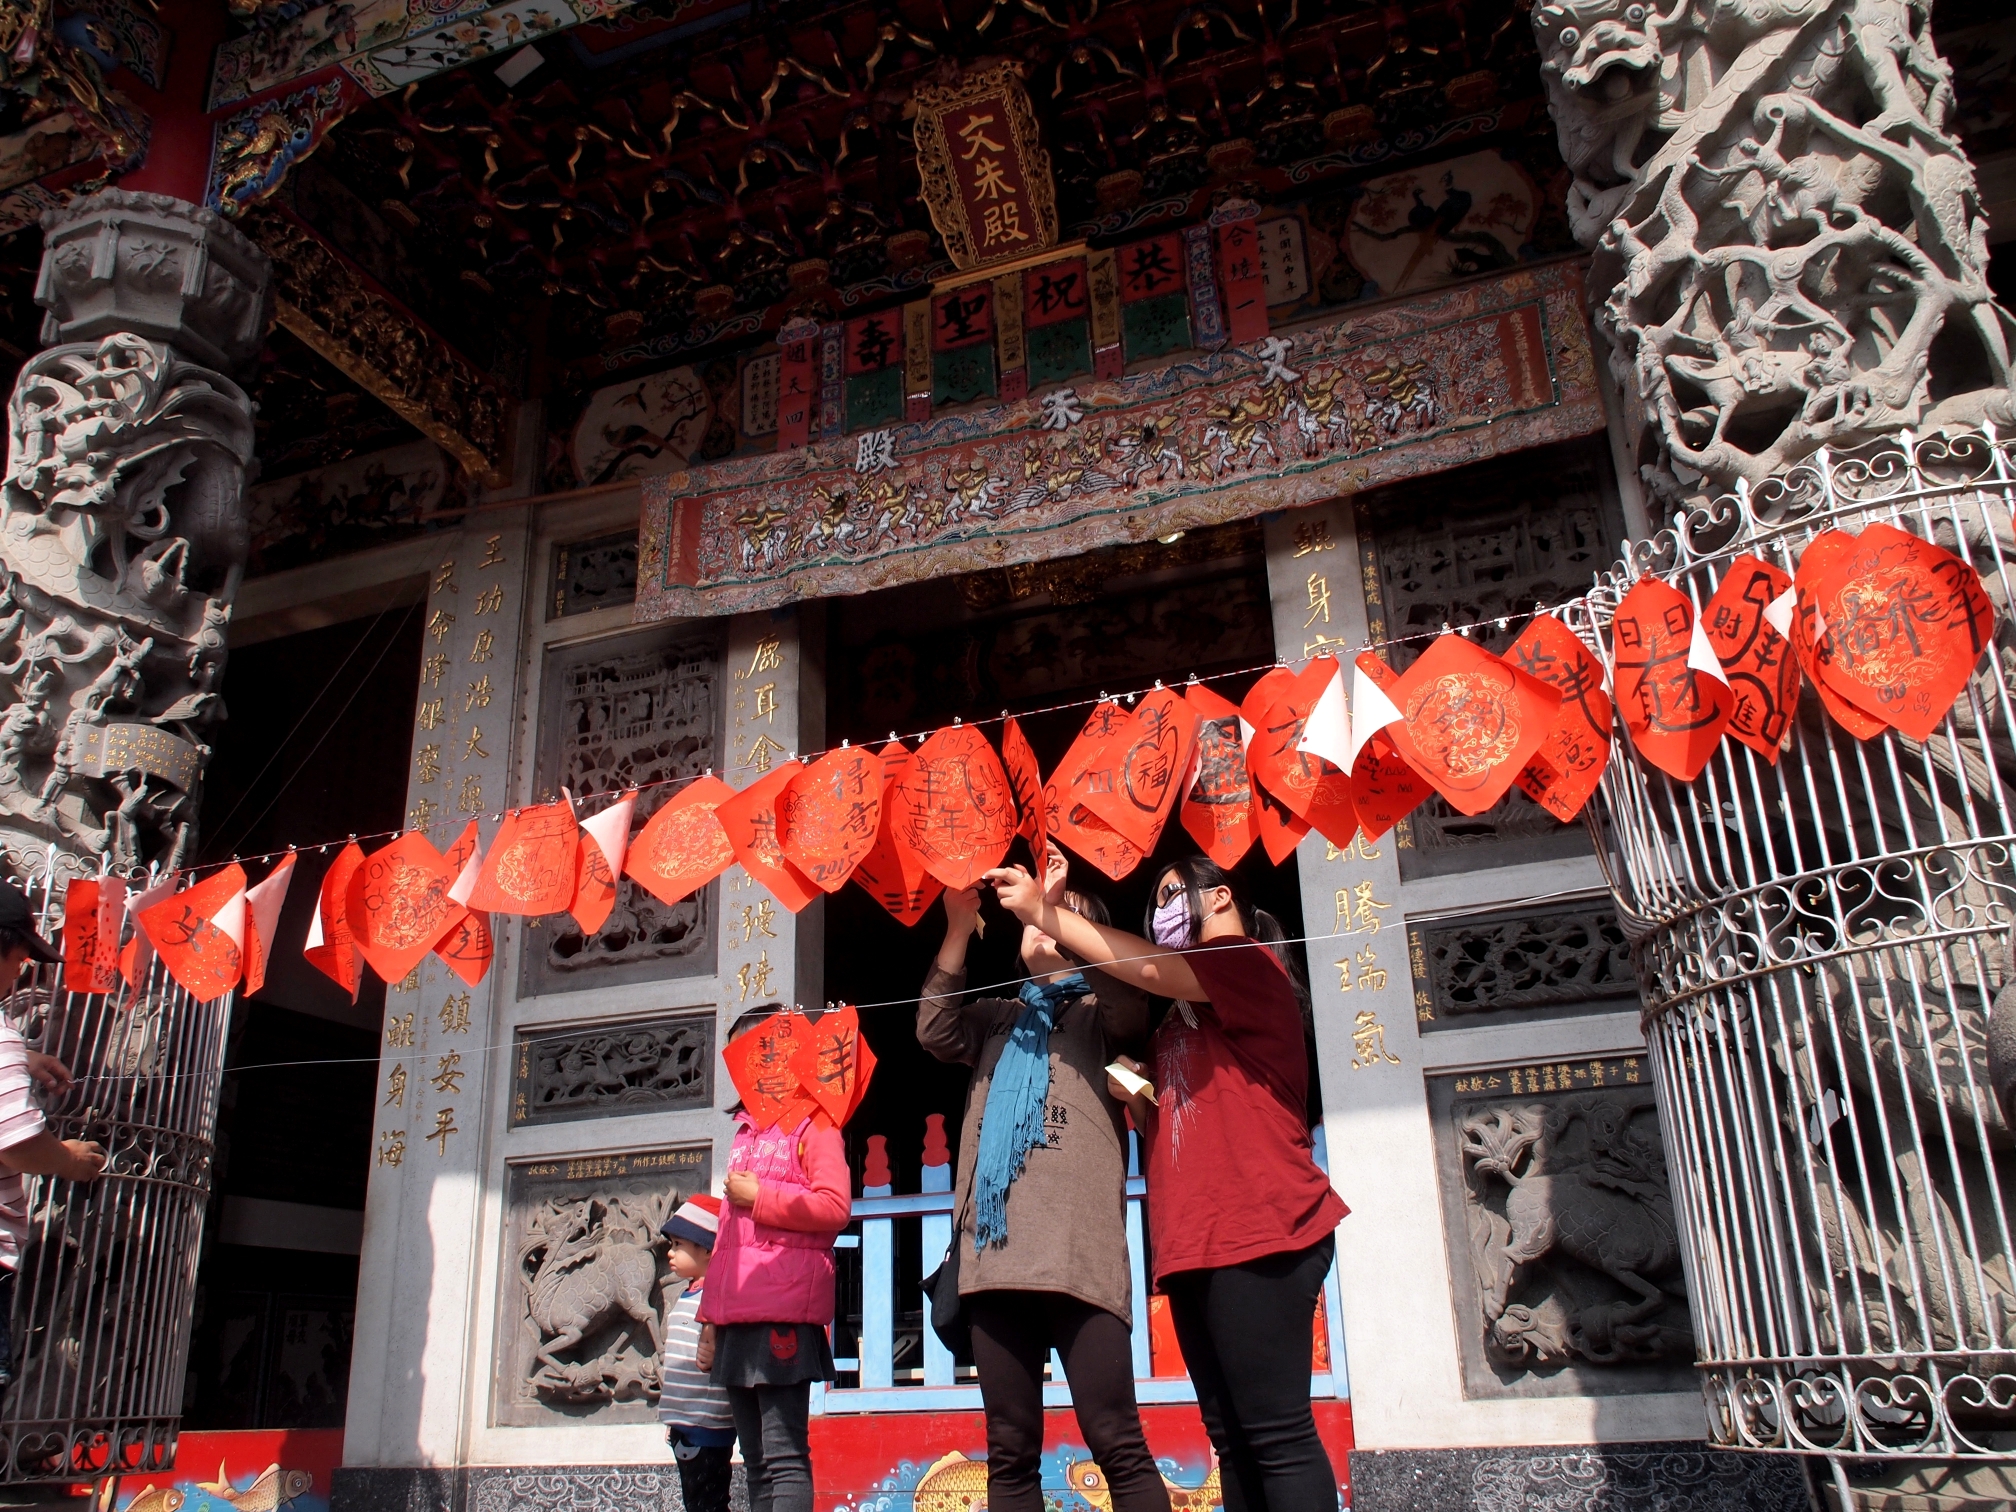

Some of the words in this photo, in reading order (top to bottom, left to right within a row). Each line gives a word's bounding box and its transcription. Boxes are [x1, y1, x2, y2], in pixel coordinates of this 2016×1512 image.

[958, 113, 1030, 248] 文朱殿
[938, 731, 976, 751] 2015
[358, 851, 405, 889] 2015
[811, 850, 860, 883] 2015
